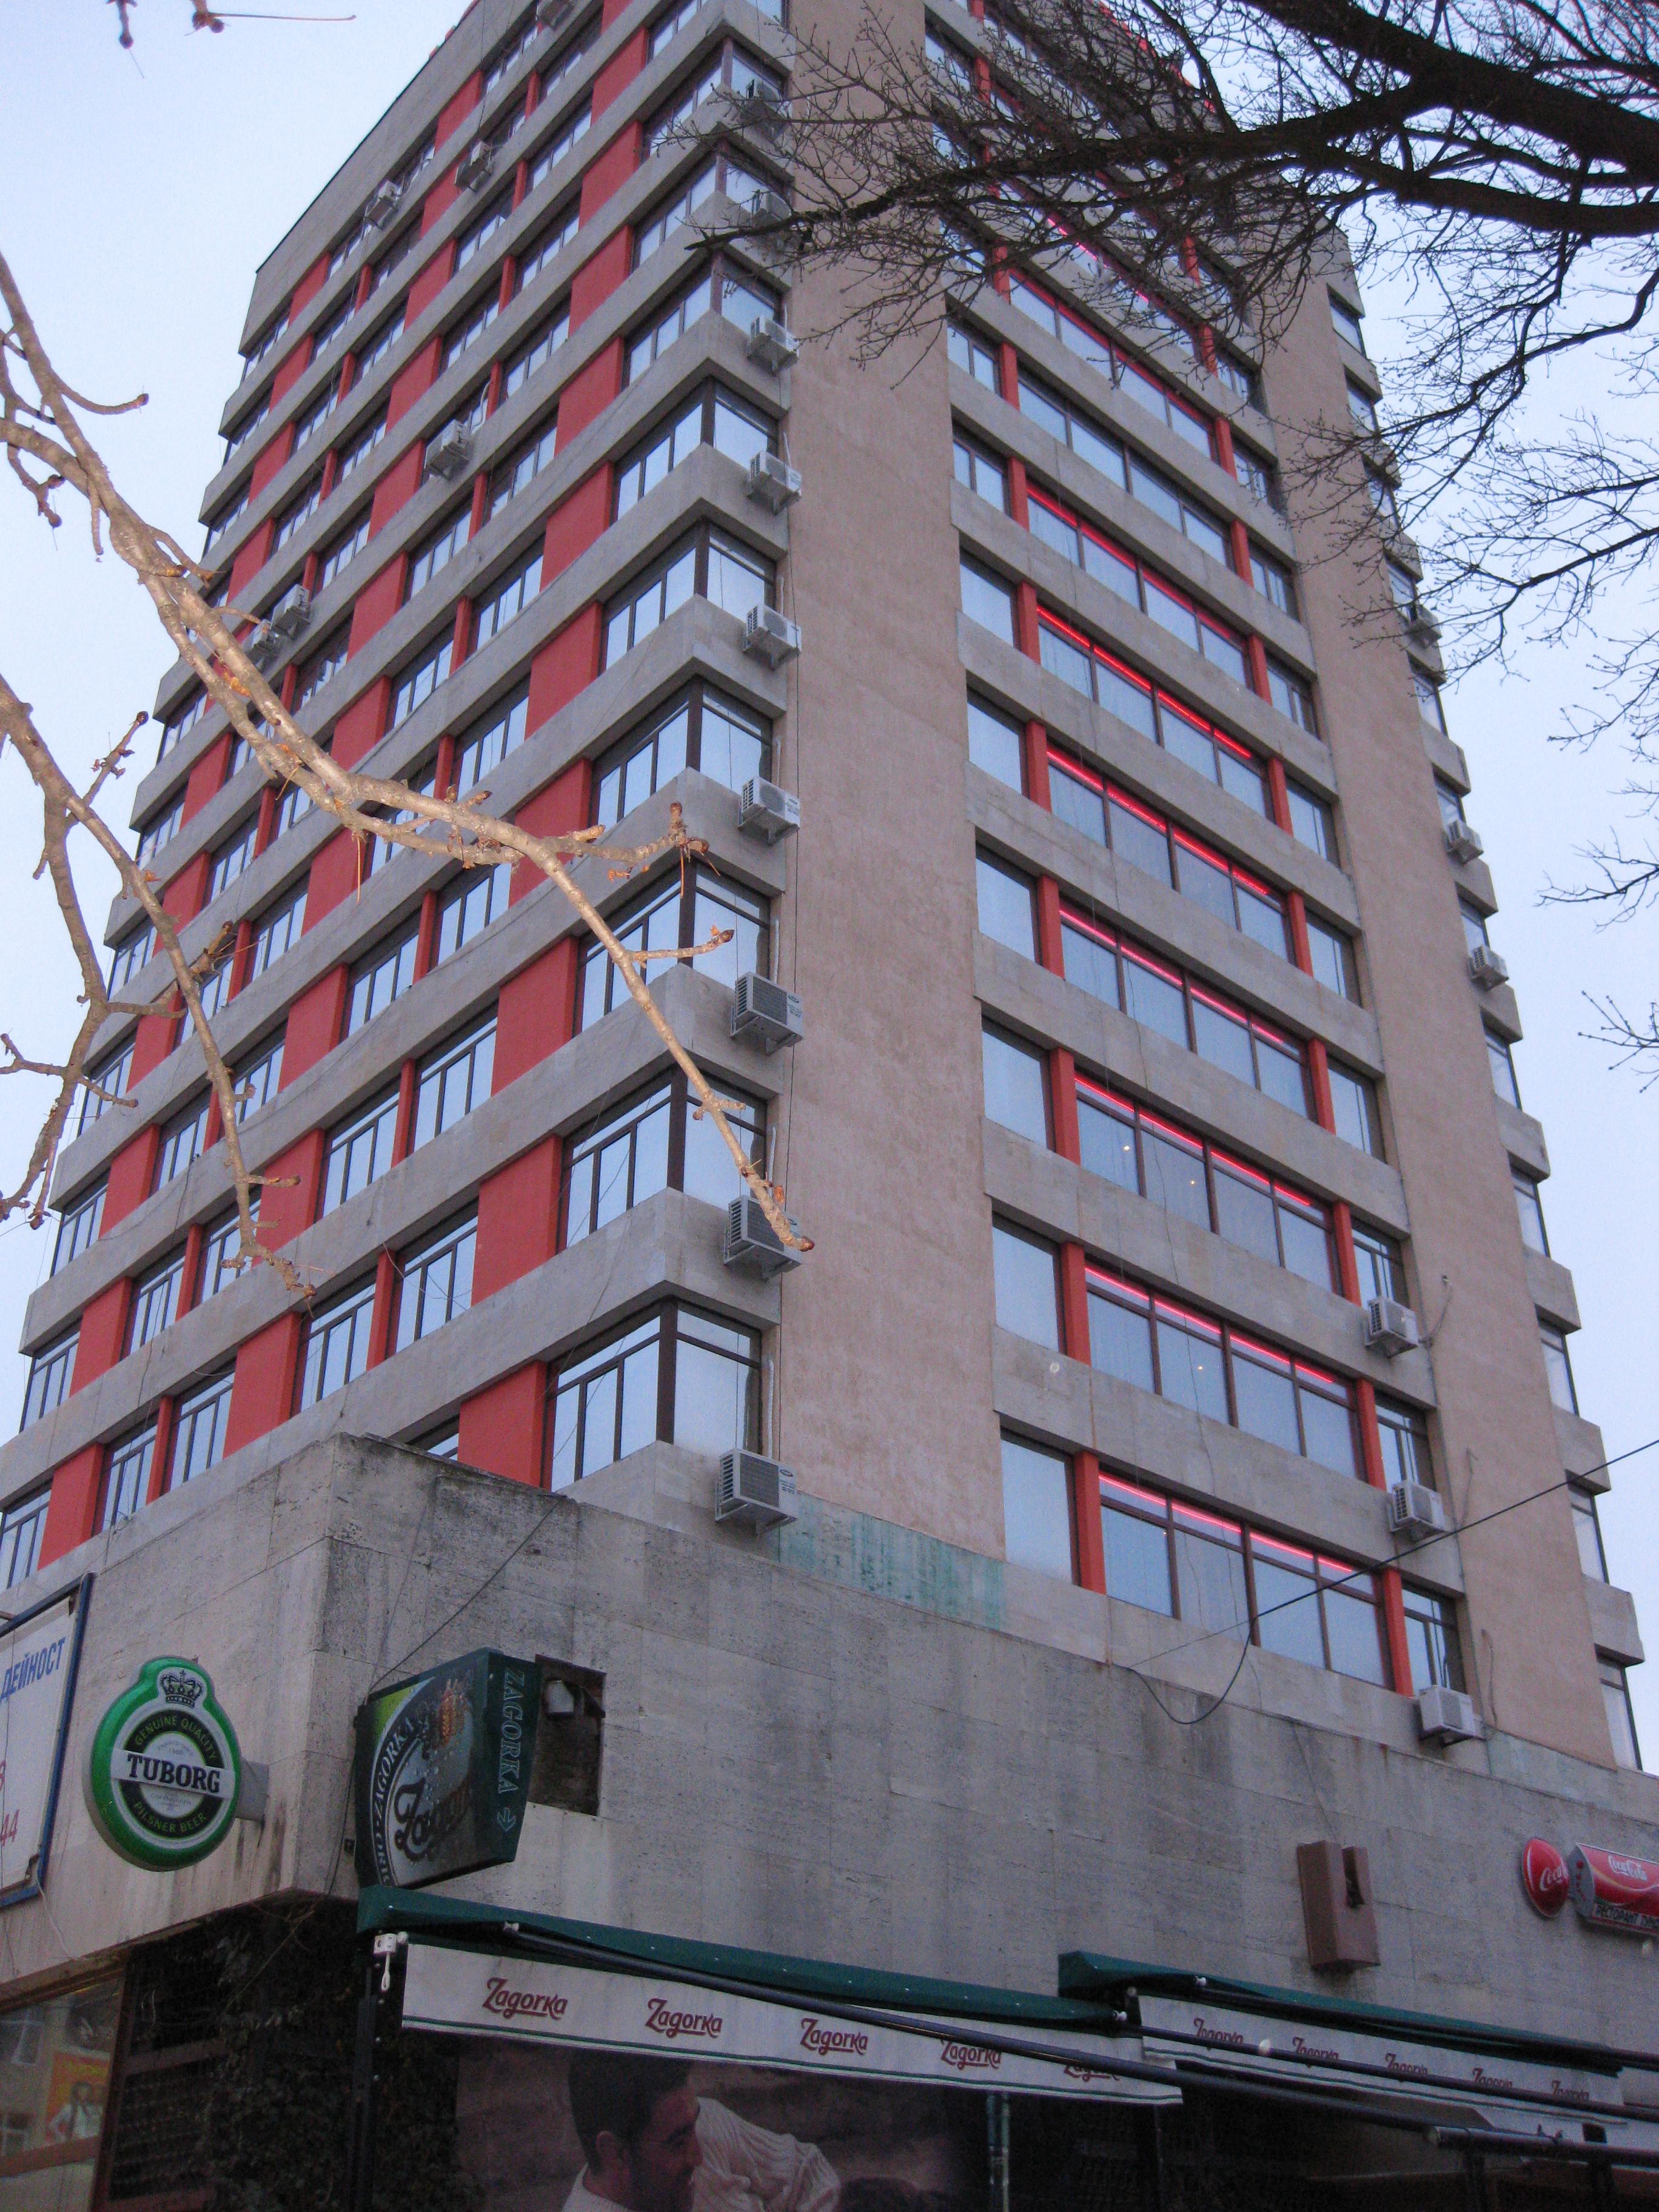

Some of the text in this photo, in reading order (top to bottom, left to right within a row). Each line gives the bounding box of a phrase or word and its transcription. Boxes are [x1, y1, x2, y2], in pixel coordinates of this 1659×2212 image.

[134, 1715, 177, 1746] GENUINE
[181, 1718, 220, 1760] QUALITY
[498, 1668, 525, 1794] ZAGORKA
[127, 1753, 221, 1793] TUBORG
[133, 1801, 207, 1833] PILSNER BEER
[482, 1977, 568, 2021] Zagorka
[645, 1998, 723, 2039] Zagorka
[800, 2017, 869, 2056] Zagorka
